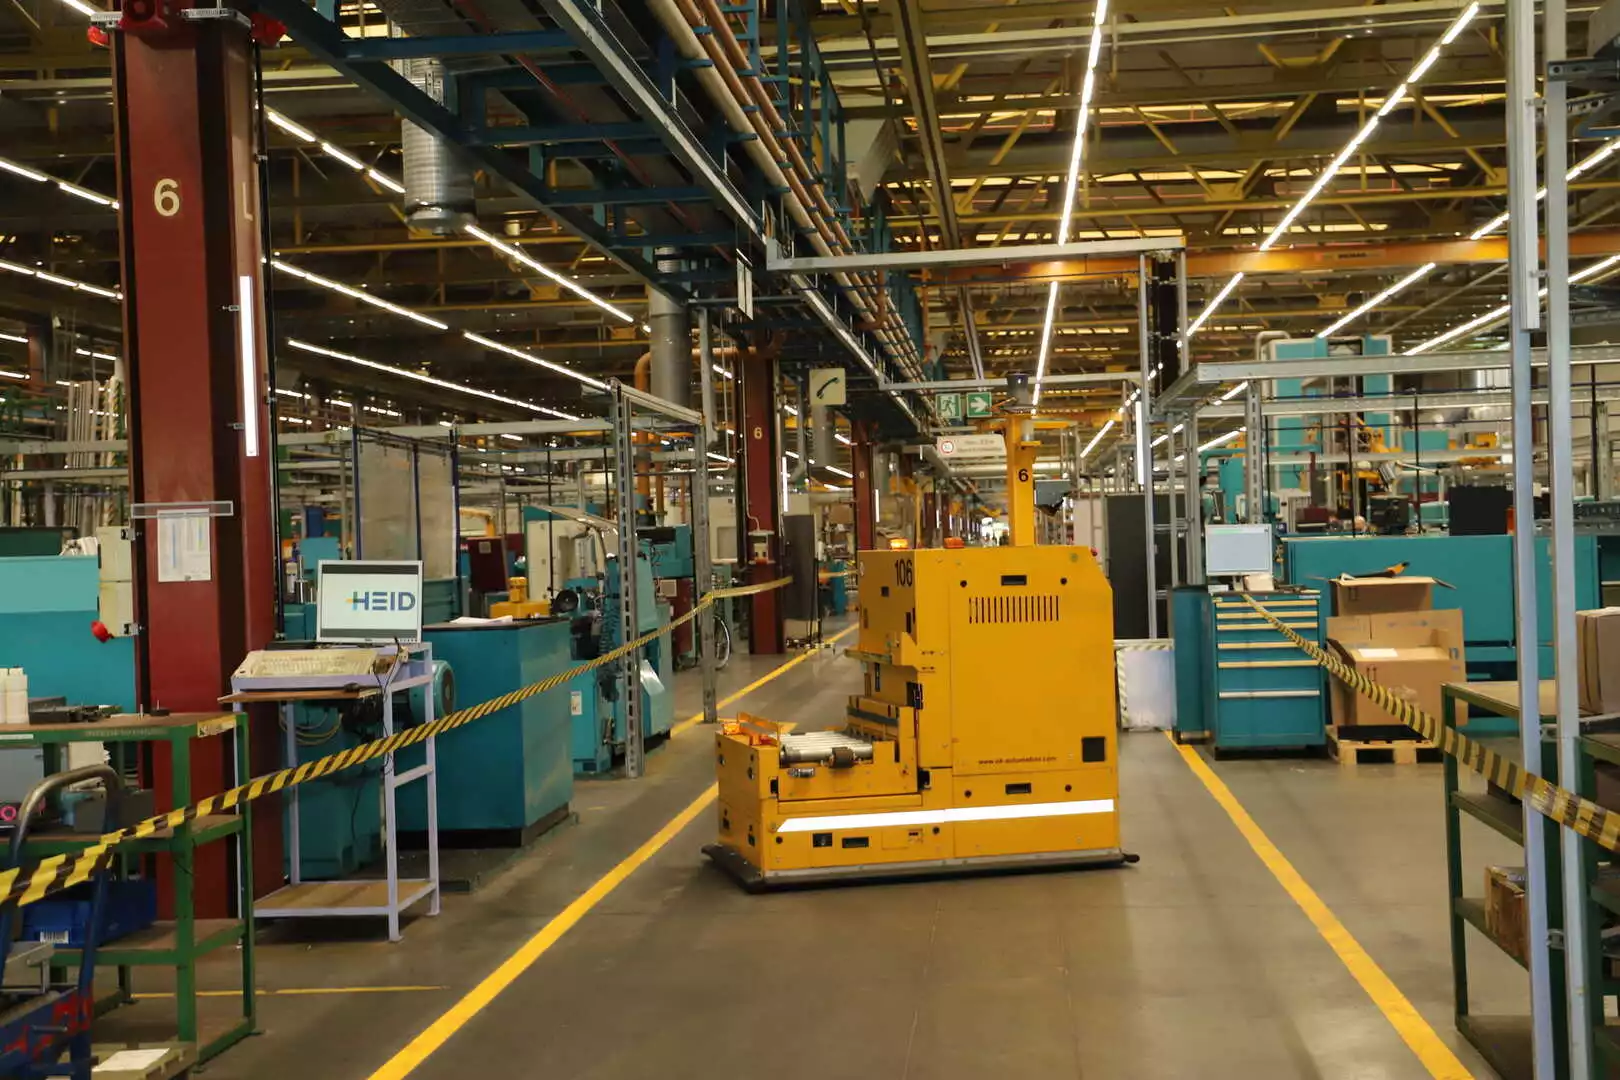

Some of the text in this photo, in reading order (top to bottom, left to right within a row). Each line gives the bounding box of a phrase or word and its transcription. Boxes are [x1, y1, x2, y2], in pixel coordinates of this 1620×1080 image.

[154, 178, 180, 217] 6
[754, 426, 763, 440] 6
[1018, 468, 1029, 482] 6
[895, 558, 913, 587] 106
[352, 591, 416, 611] HEID
